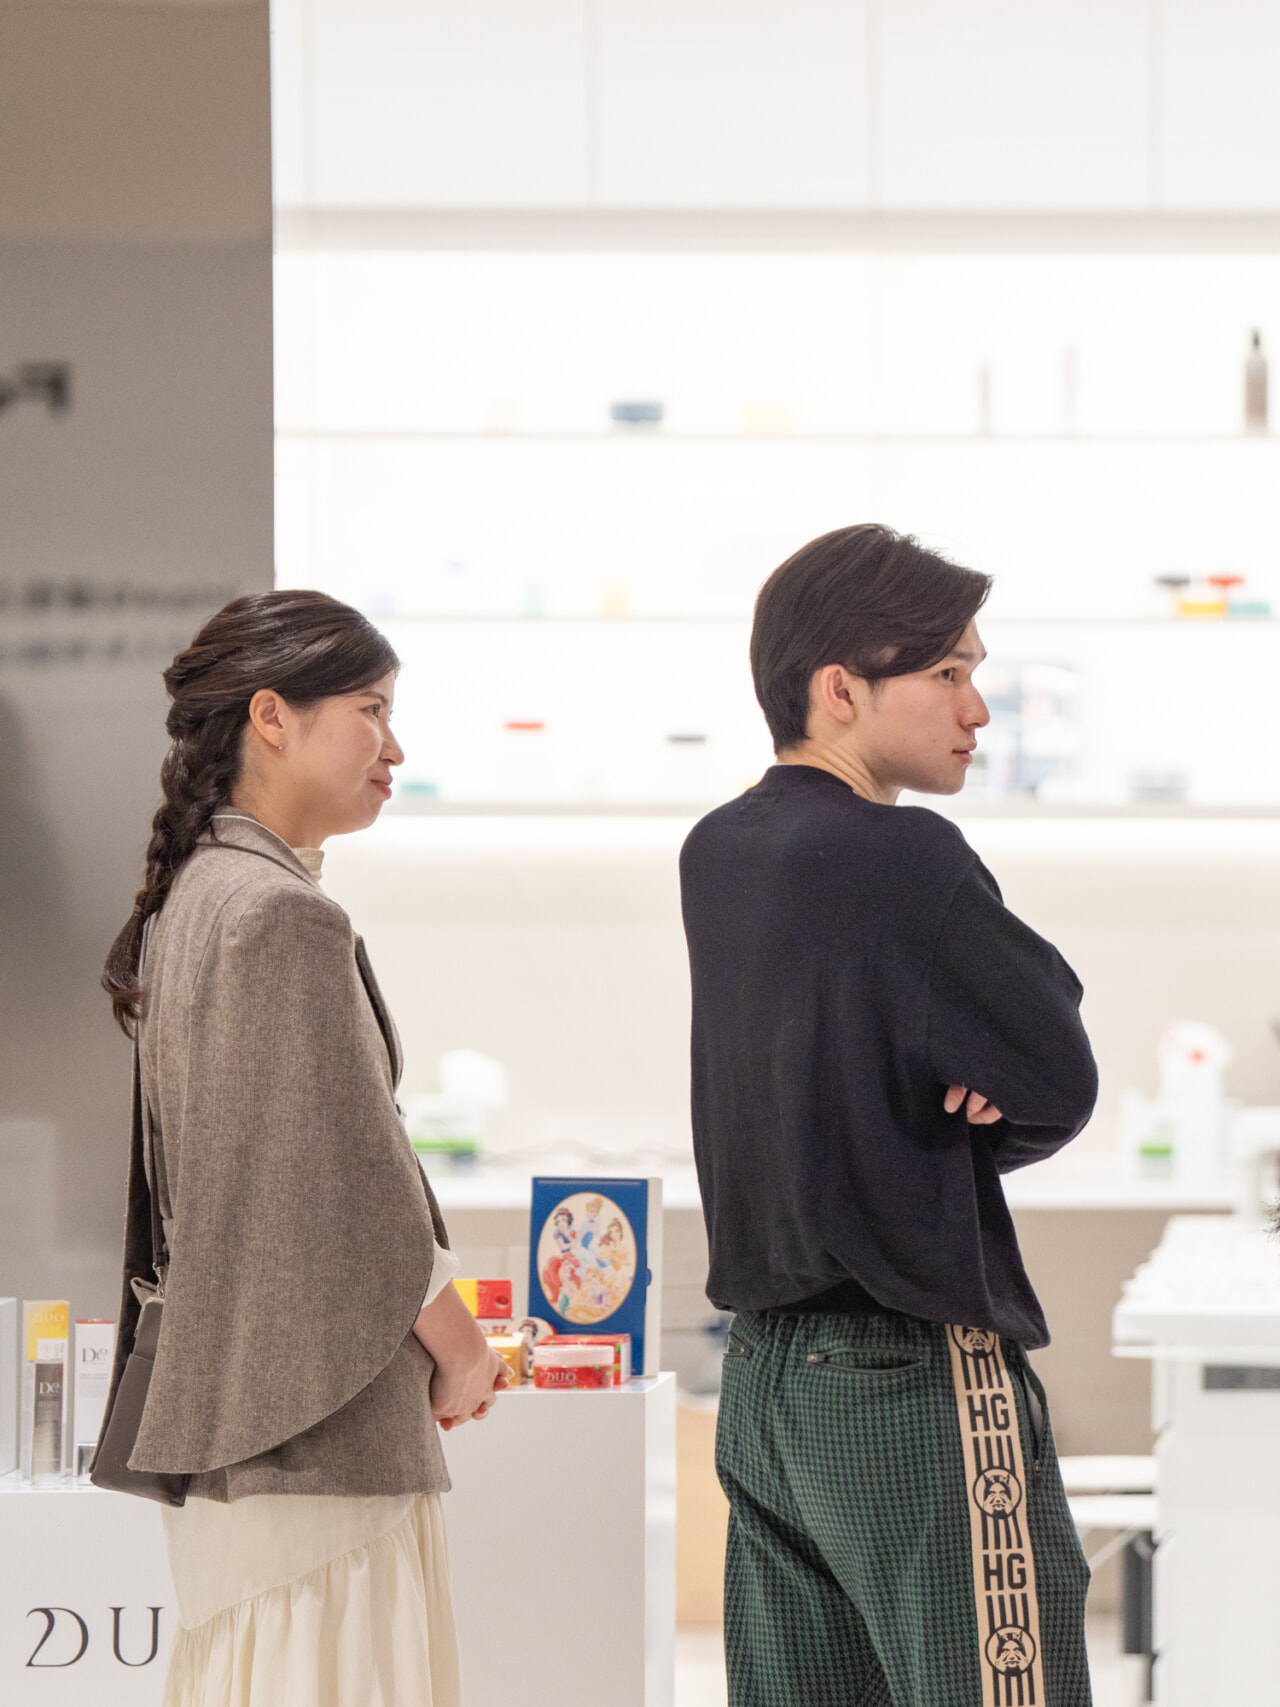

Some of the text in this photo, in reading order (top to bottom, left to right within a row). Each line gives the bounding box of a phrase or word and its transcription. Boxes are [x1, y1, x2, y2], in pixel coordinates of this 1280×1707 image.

[546, 1371, 577, 1383] DUO
[966, 1392, 1011, 1432] HG
[982, 1552, 1028, 1592] HG
